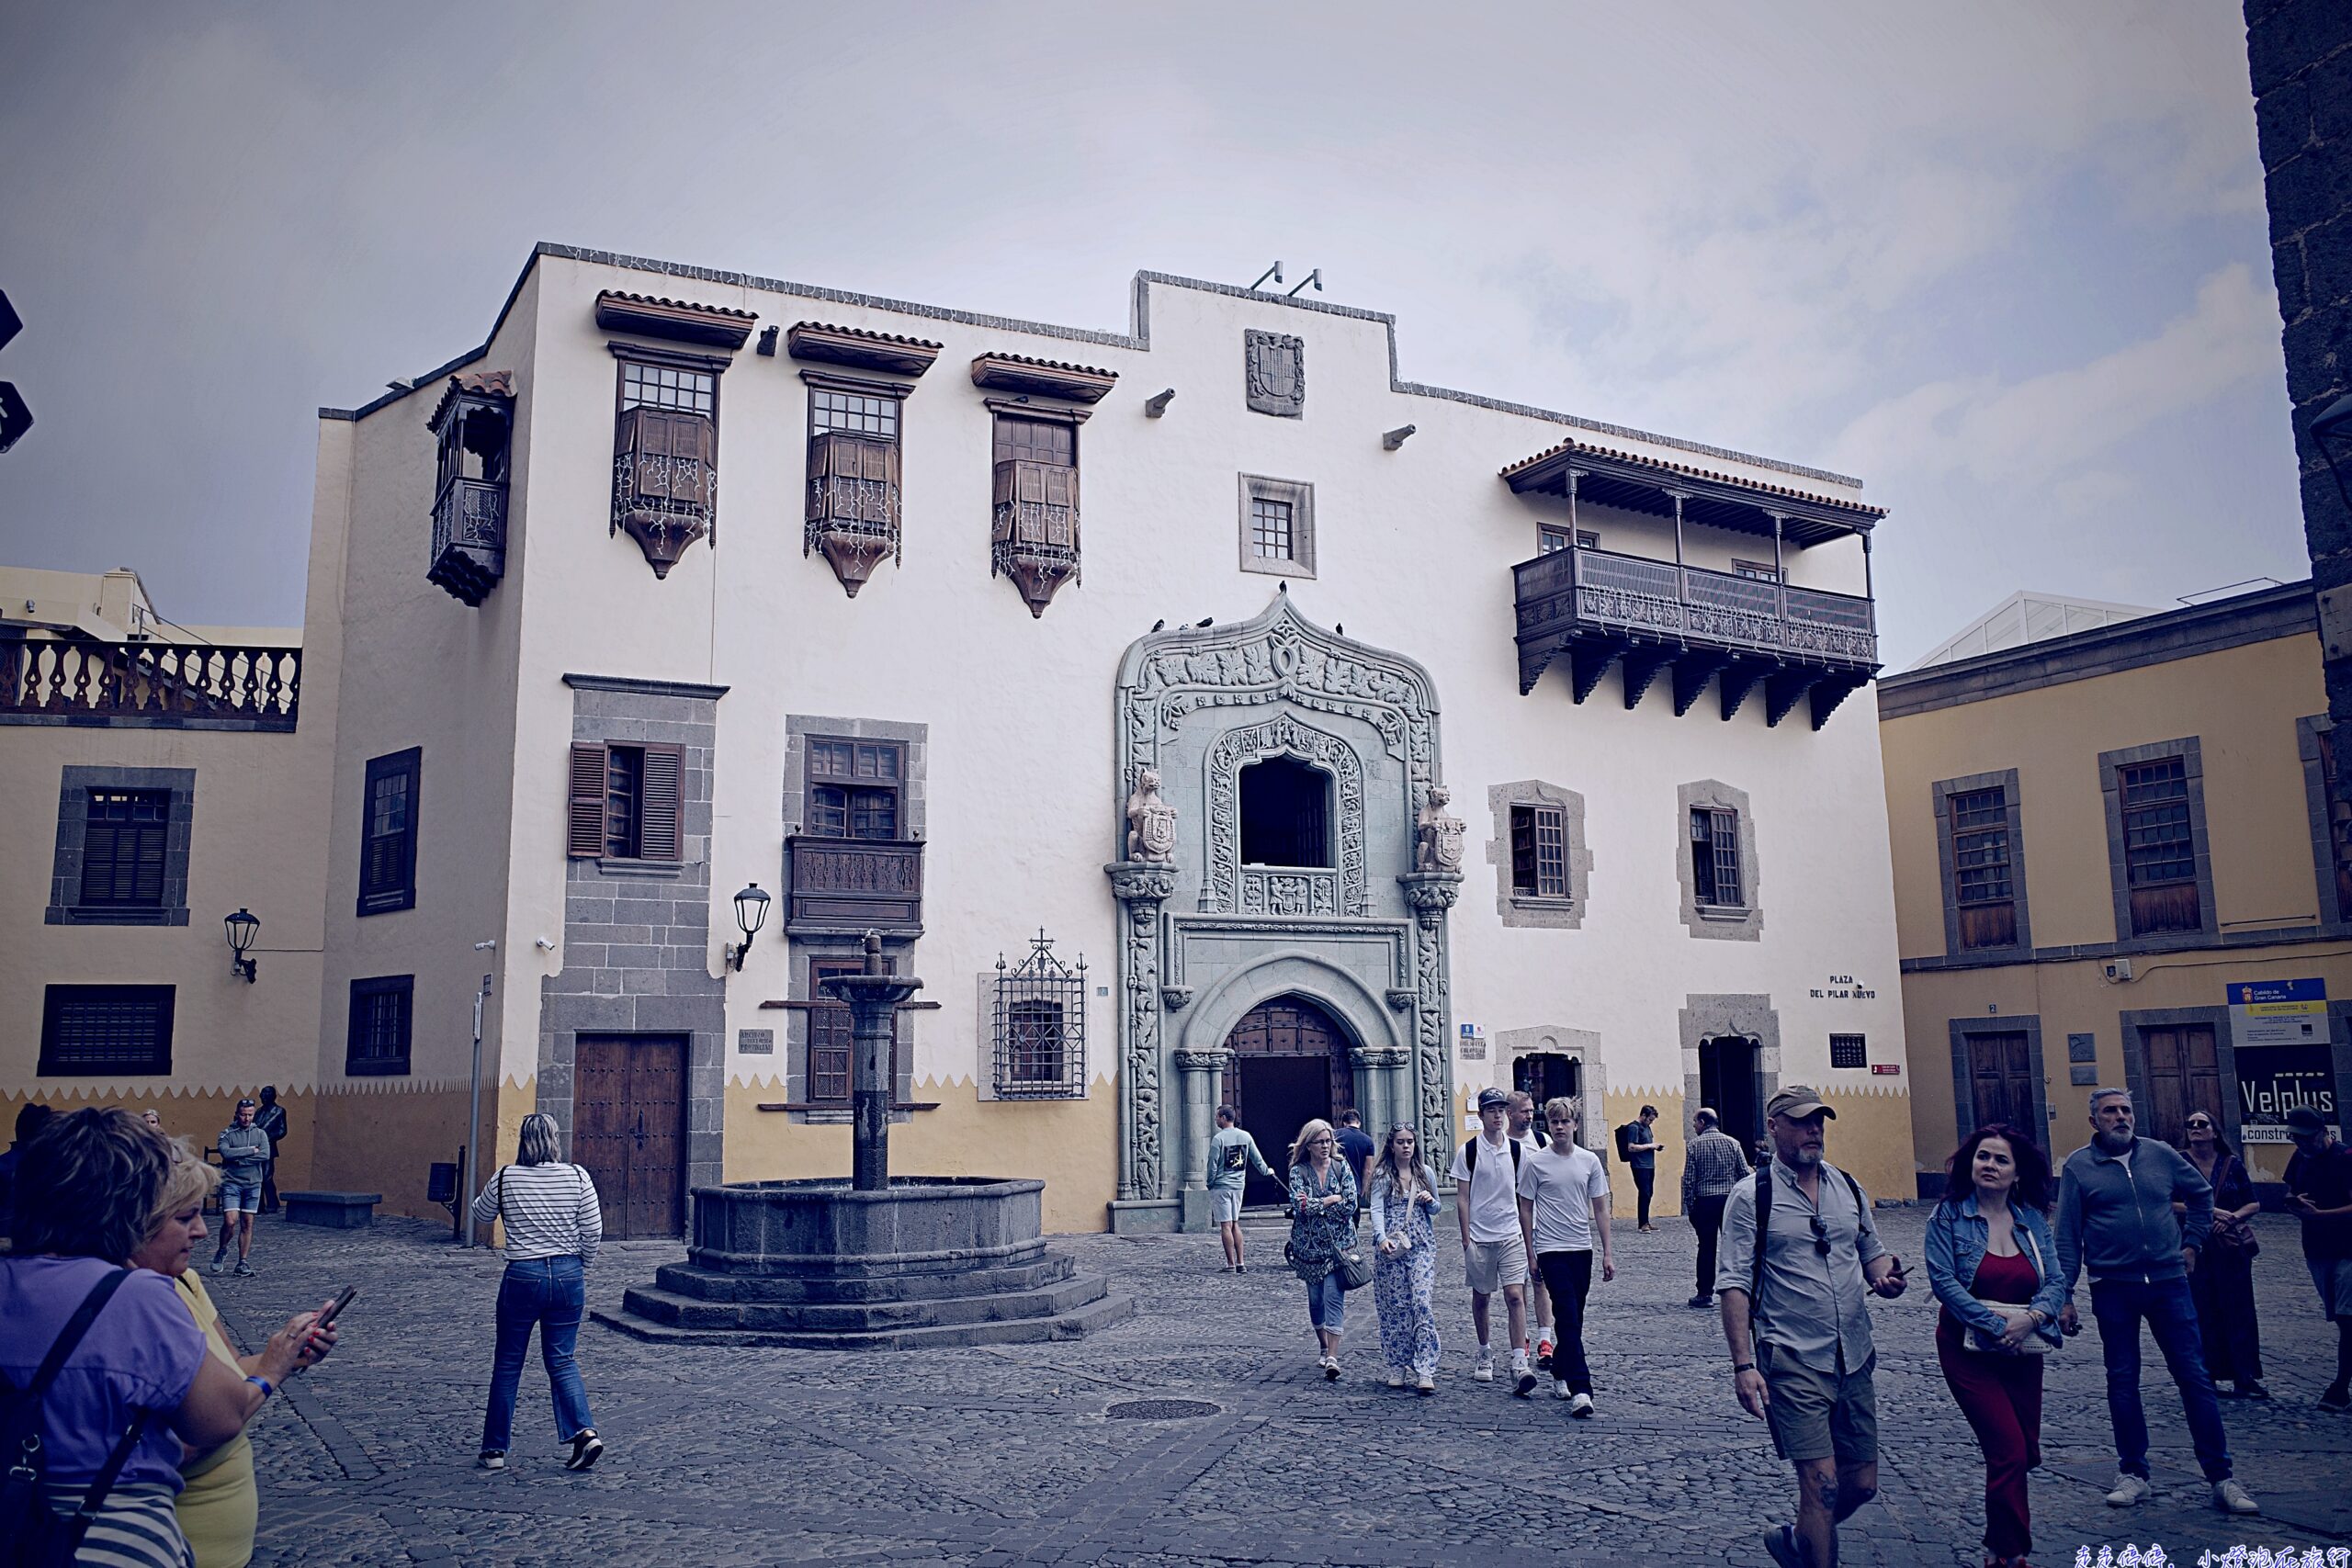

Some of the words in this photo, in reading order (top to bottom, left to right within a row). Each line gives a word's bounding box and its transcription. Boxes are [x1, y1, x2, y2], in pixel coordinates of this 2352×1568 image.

[1829, 976, 1853, 984] PLAZA
[1810, 989, 1824, 998] DEL
[1827, 989, 1849, 998] PILAR
[2241, 1079, 2334, 1120] Velplus
